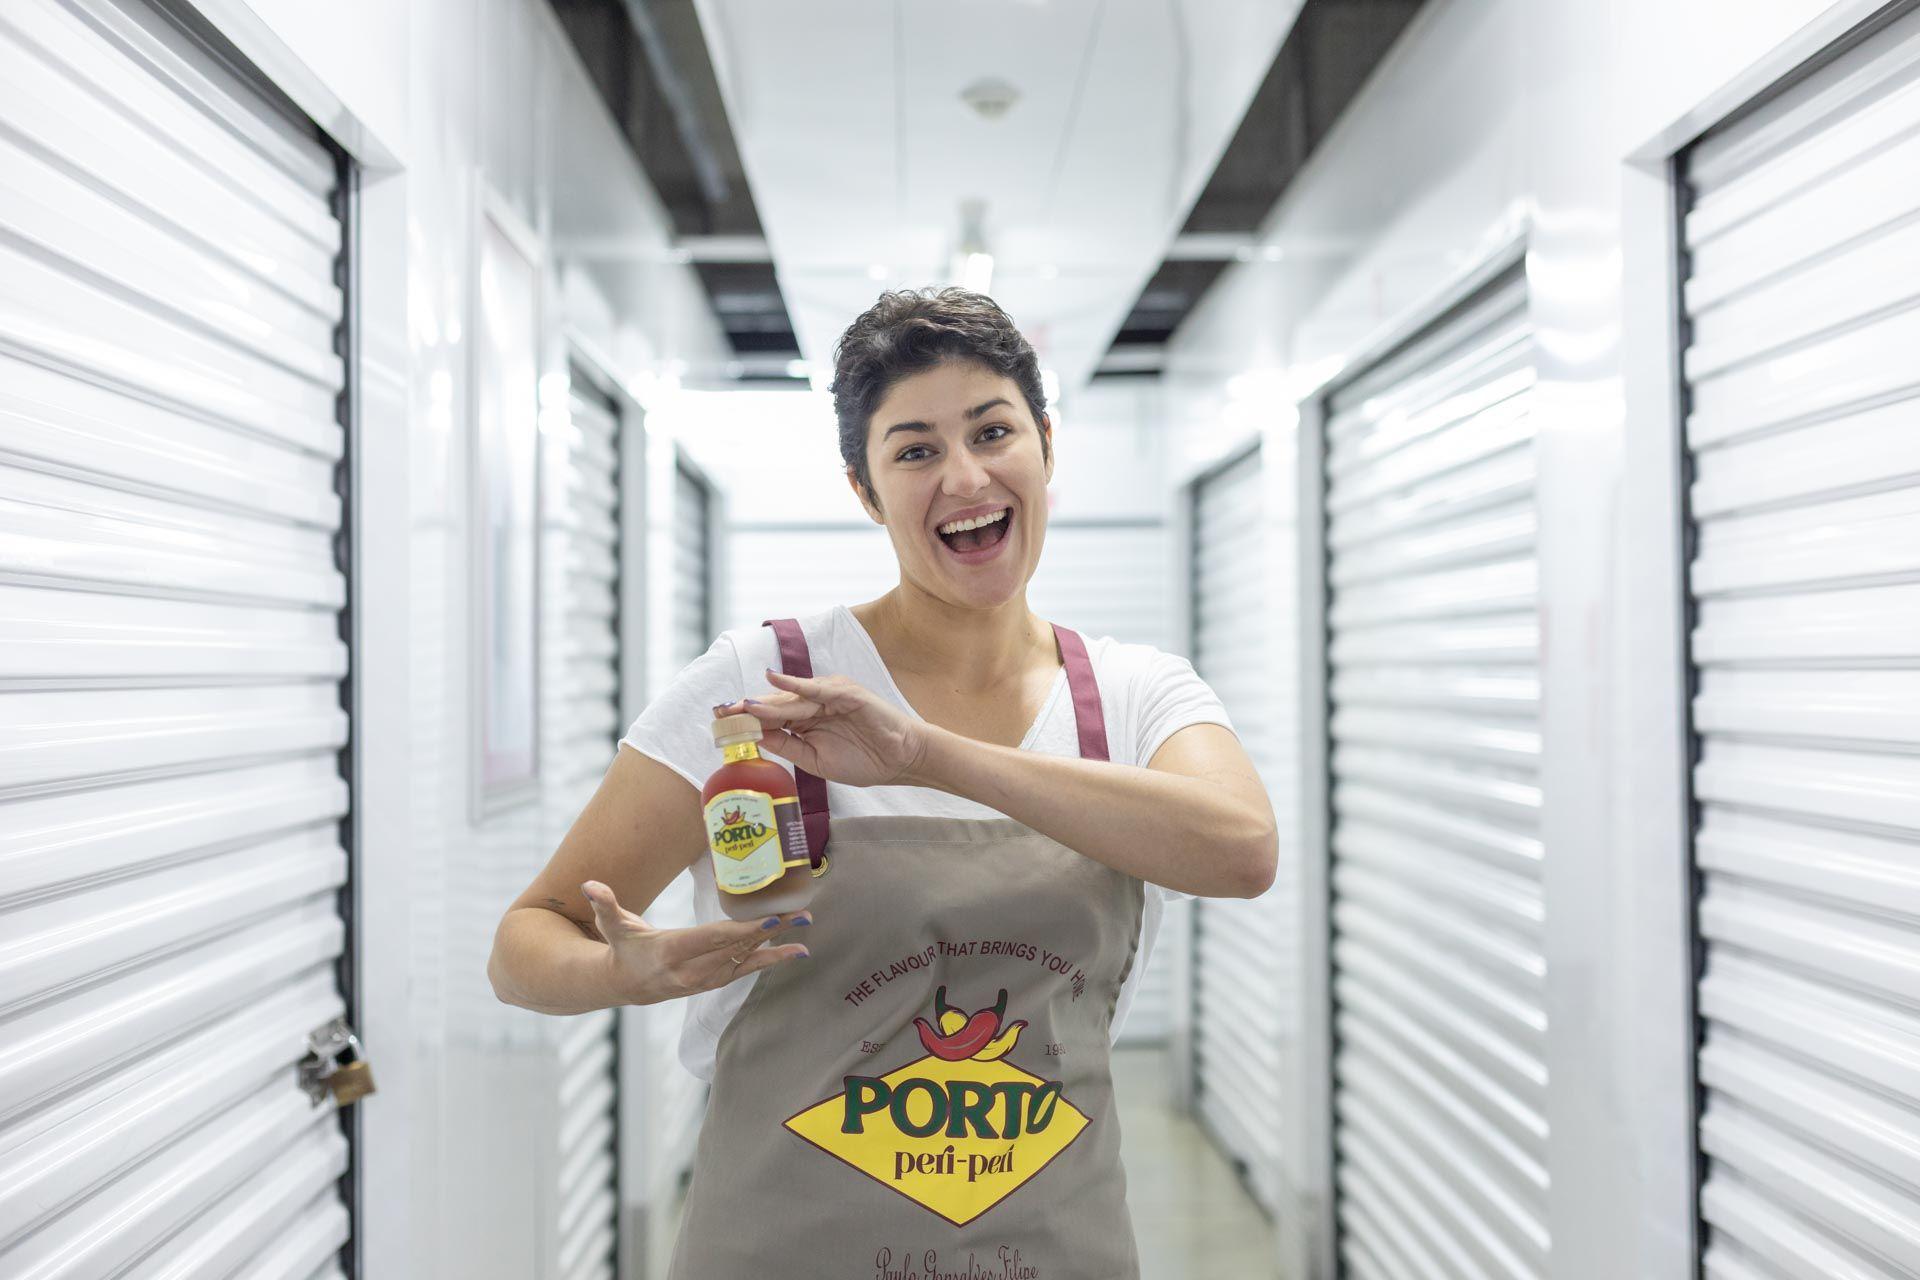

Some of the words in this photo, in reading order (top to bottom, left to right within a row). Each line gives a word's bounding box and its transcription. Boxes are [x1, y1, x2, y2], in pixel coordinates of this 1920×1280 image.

[714, 822, 766, 846] PORTO
[844, 980, 875, 1007] THE
[871, 946, 936, 987] FLAVOUR
[936, 941, 977, 957] THAT
[980, 941, 1037, 961] BRINGS
[1041, 949, 1074, 975] YOU
[840, 1075, 1064, 1140] PORTO
[894, 1144, 1015, 1182] peri-peri
[875, 1246, 919, 1280] Paulo
